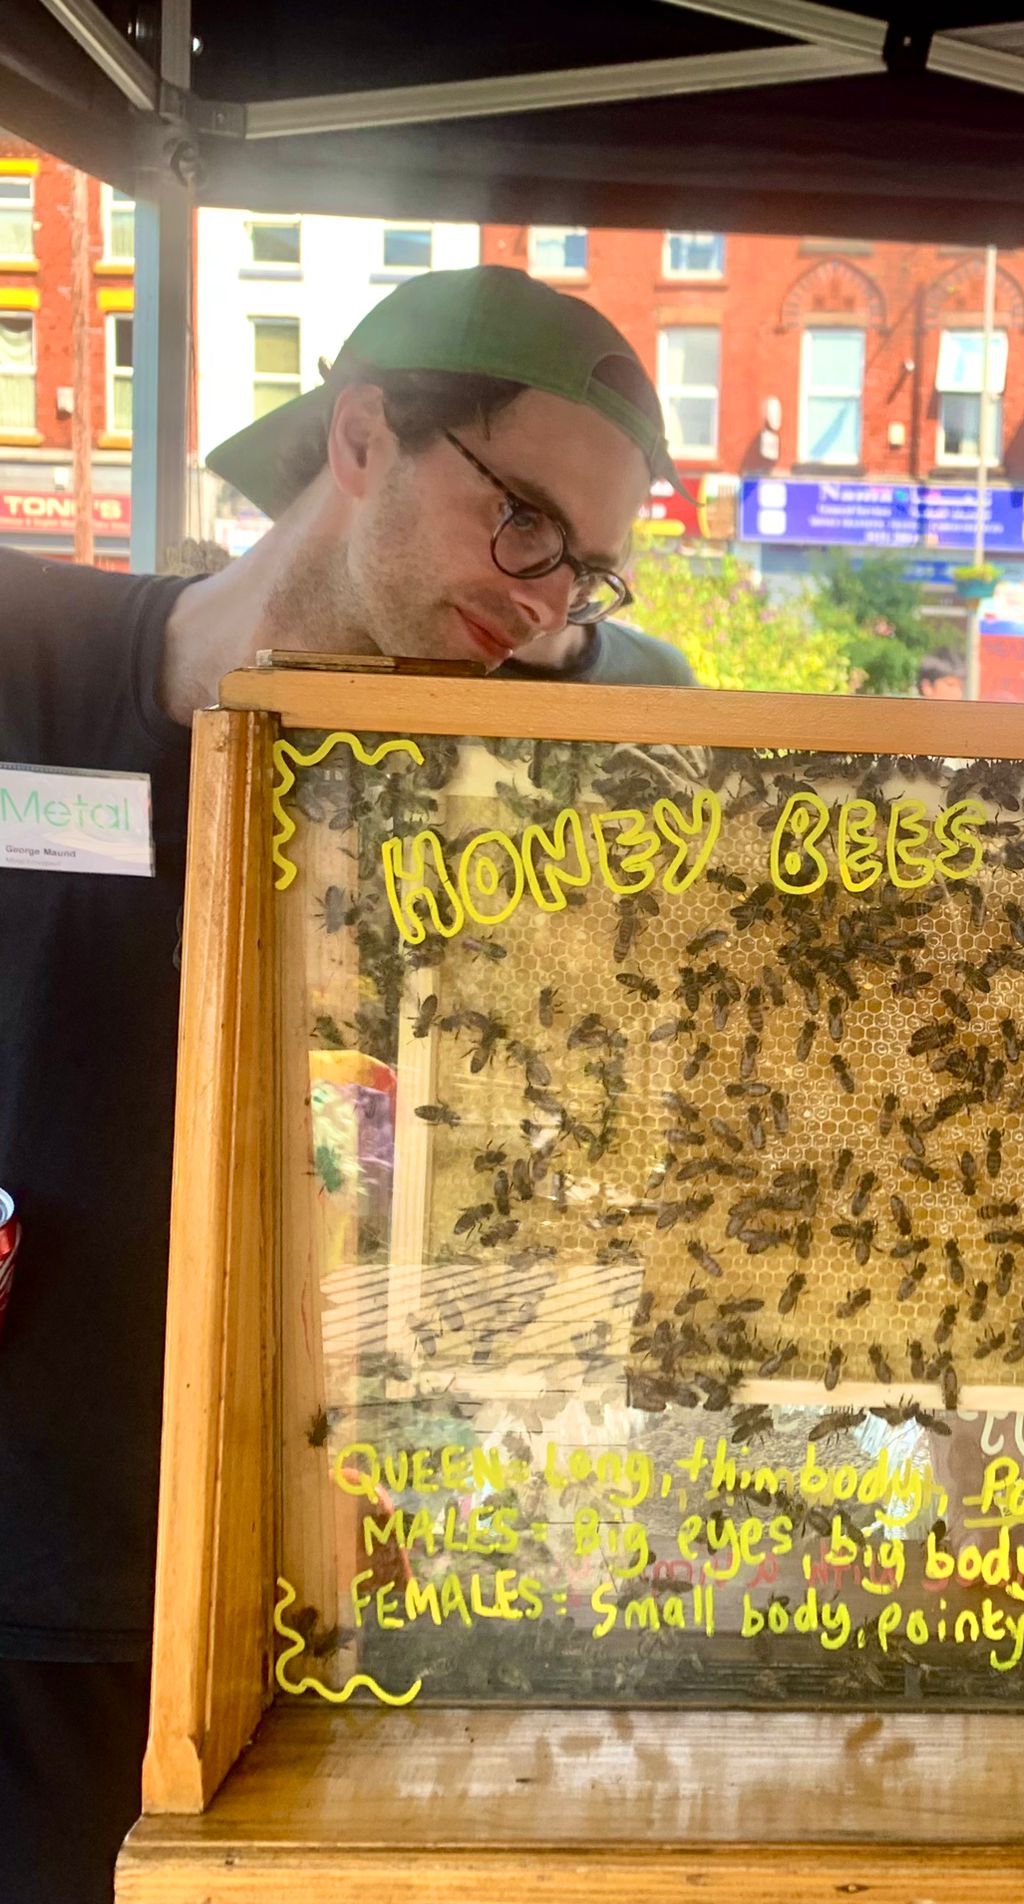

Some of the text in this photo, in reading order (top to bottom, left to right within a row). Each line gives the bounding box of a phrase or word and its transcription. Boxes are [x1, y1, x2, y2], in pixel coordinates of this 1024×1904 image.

[3, 495, 122, 520] TON'S
[0, 787, 129, 831] Metal
[5, 845, 76, 858] George Maund
[382, 790, 986, 945] HONEY BEES
[676, 1437, 778, 1491] thin
[574, 1507, 654, 1578] Big
[826, 1515, 906, 1595] big
